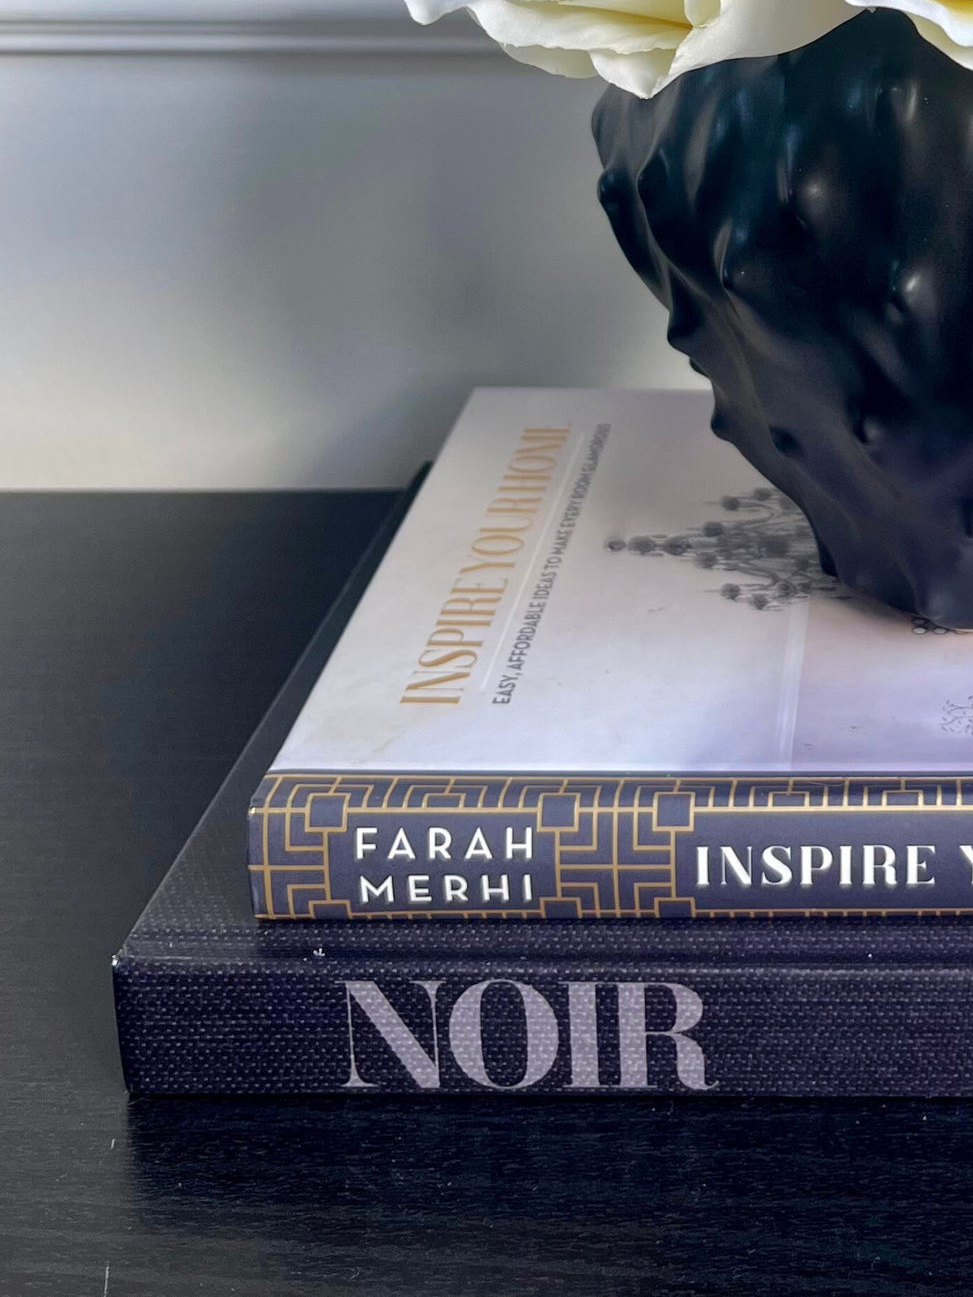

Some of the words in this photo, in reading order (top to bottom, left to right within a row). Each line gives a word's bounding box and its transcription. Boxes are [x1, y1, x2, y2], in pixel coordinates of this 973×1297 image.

[560, 499, 582, 528] EVERY
[550, 527, 573, 555] MAKE
[544, 555, 562, 572] TO
[400, 578, 509, 704] INSPIRE
[460, 496, 543, 574] YOUR
[532, 570, 557, 600] IDEAS
[506, 602, 547, 671] AFFORDABLE
[492, 672, 523, 704] EASY,
[354, 826, 535, 861] FARAH
[694, 843, 937, 887] INSPIRE
[358, 872, 534, 904] MERHI
[334, 978, 720, 1091] NOIR
